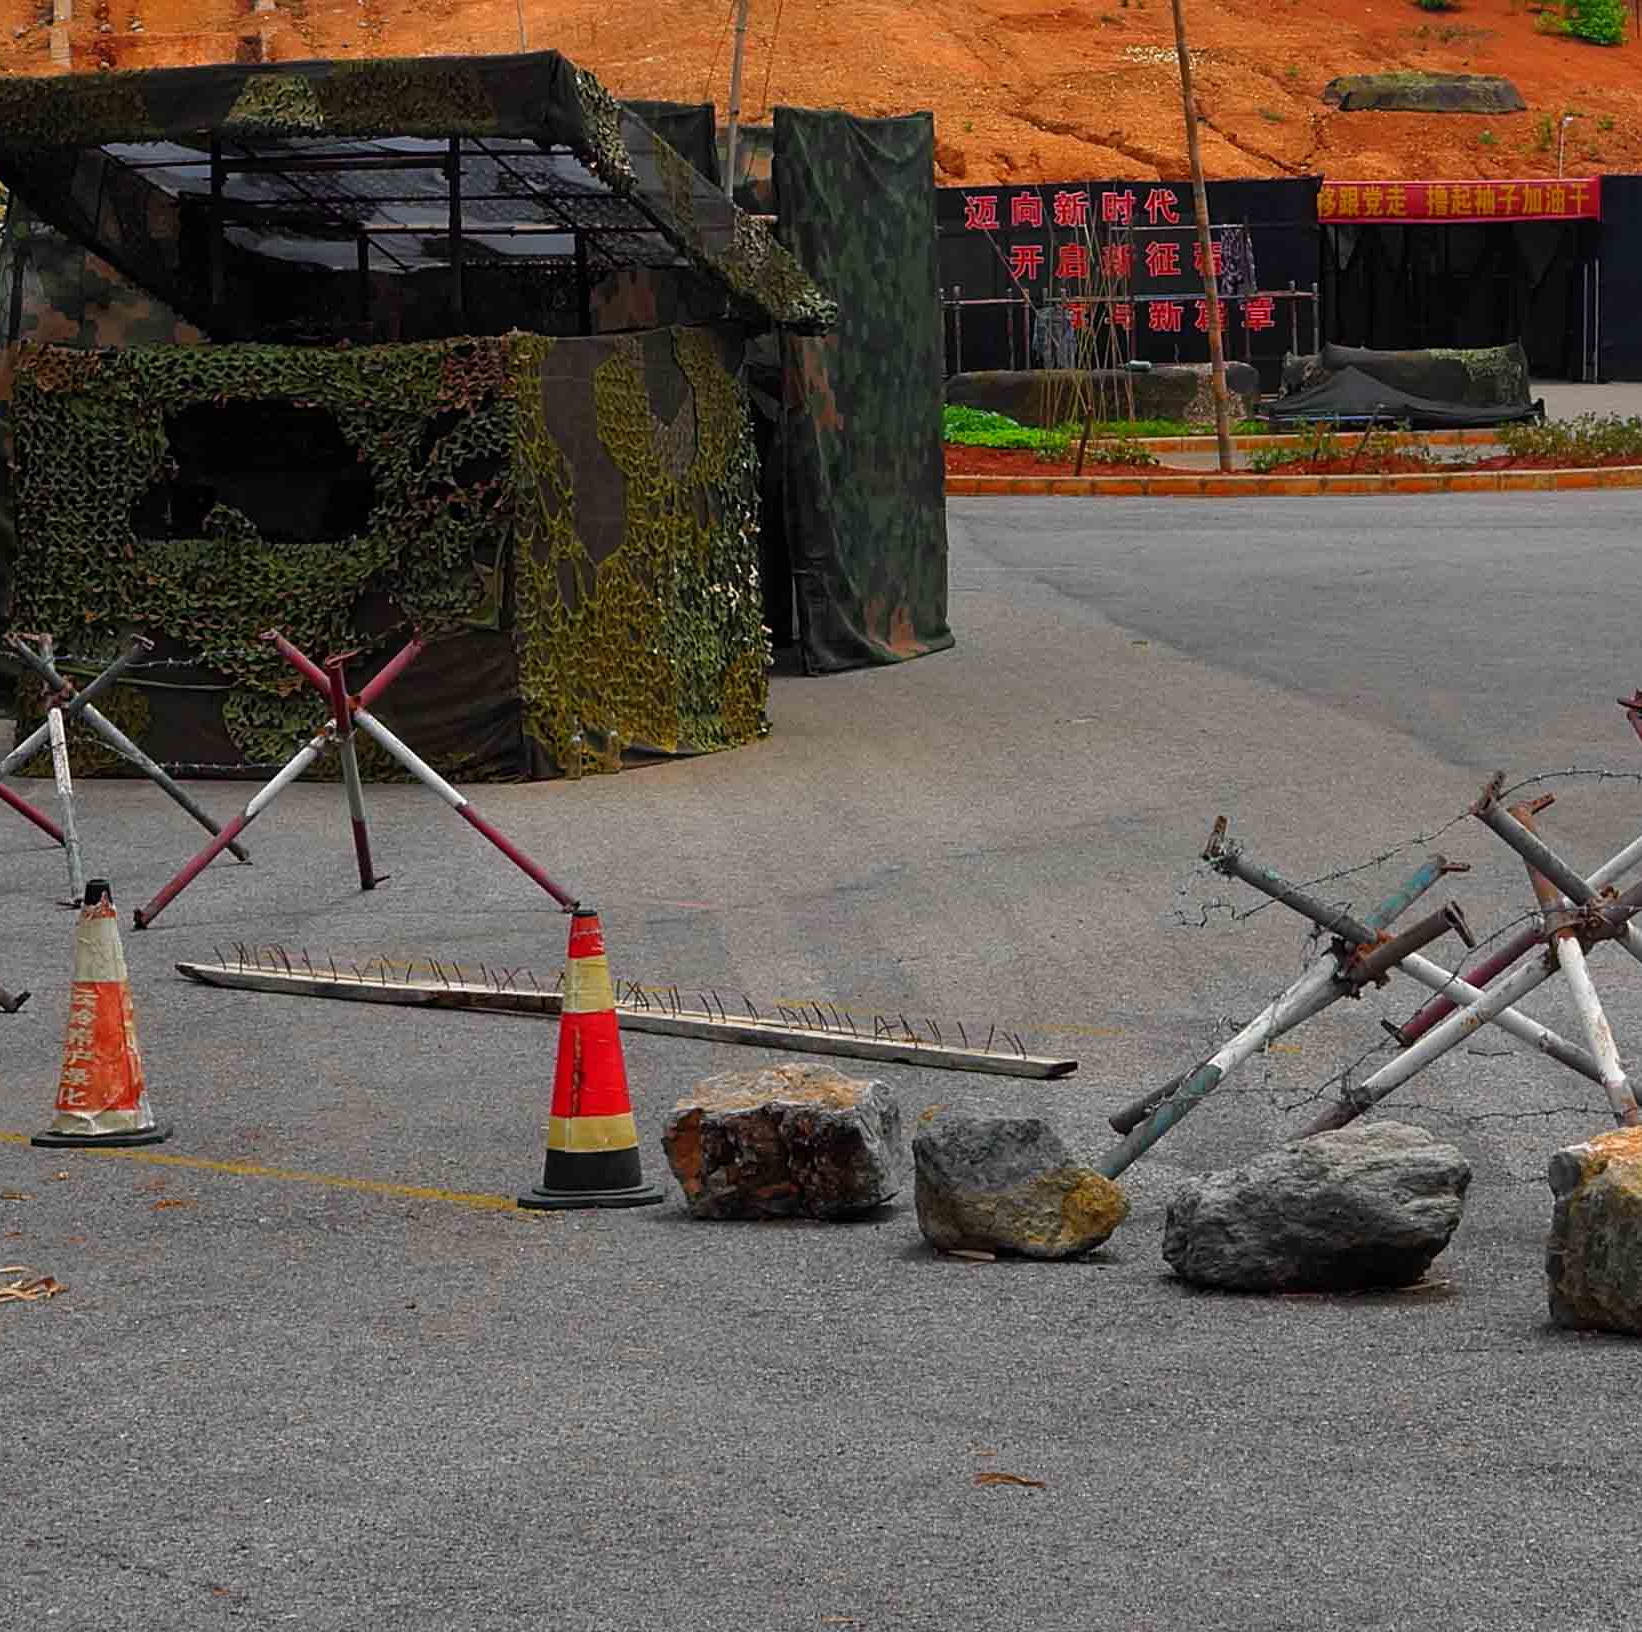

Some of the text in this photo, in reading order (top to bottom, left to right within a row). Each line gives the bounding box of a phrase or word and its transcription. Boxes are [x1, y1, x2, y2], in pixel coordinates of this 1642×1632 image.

[964, 188, 1182, 230] 迈向新时代
[1425, 182, 1590, 216] 撸起袖子加油干
